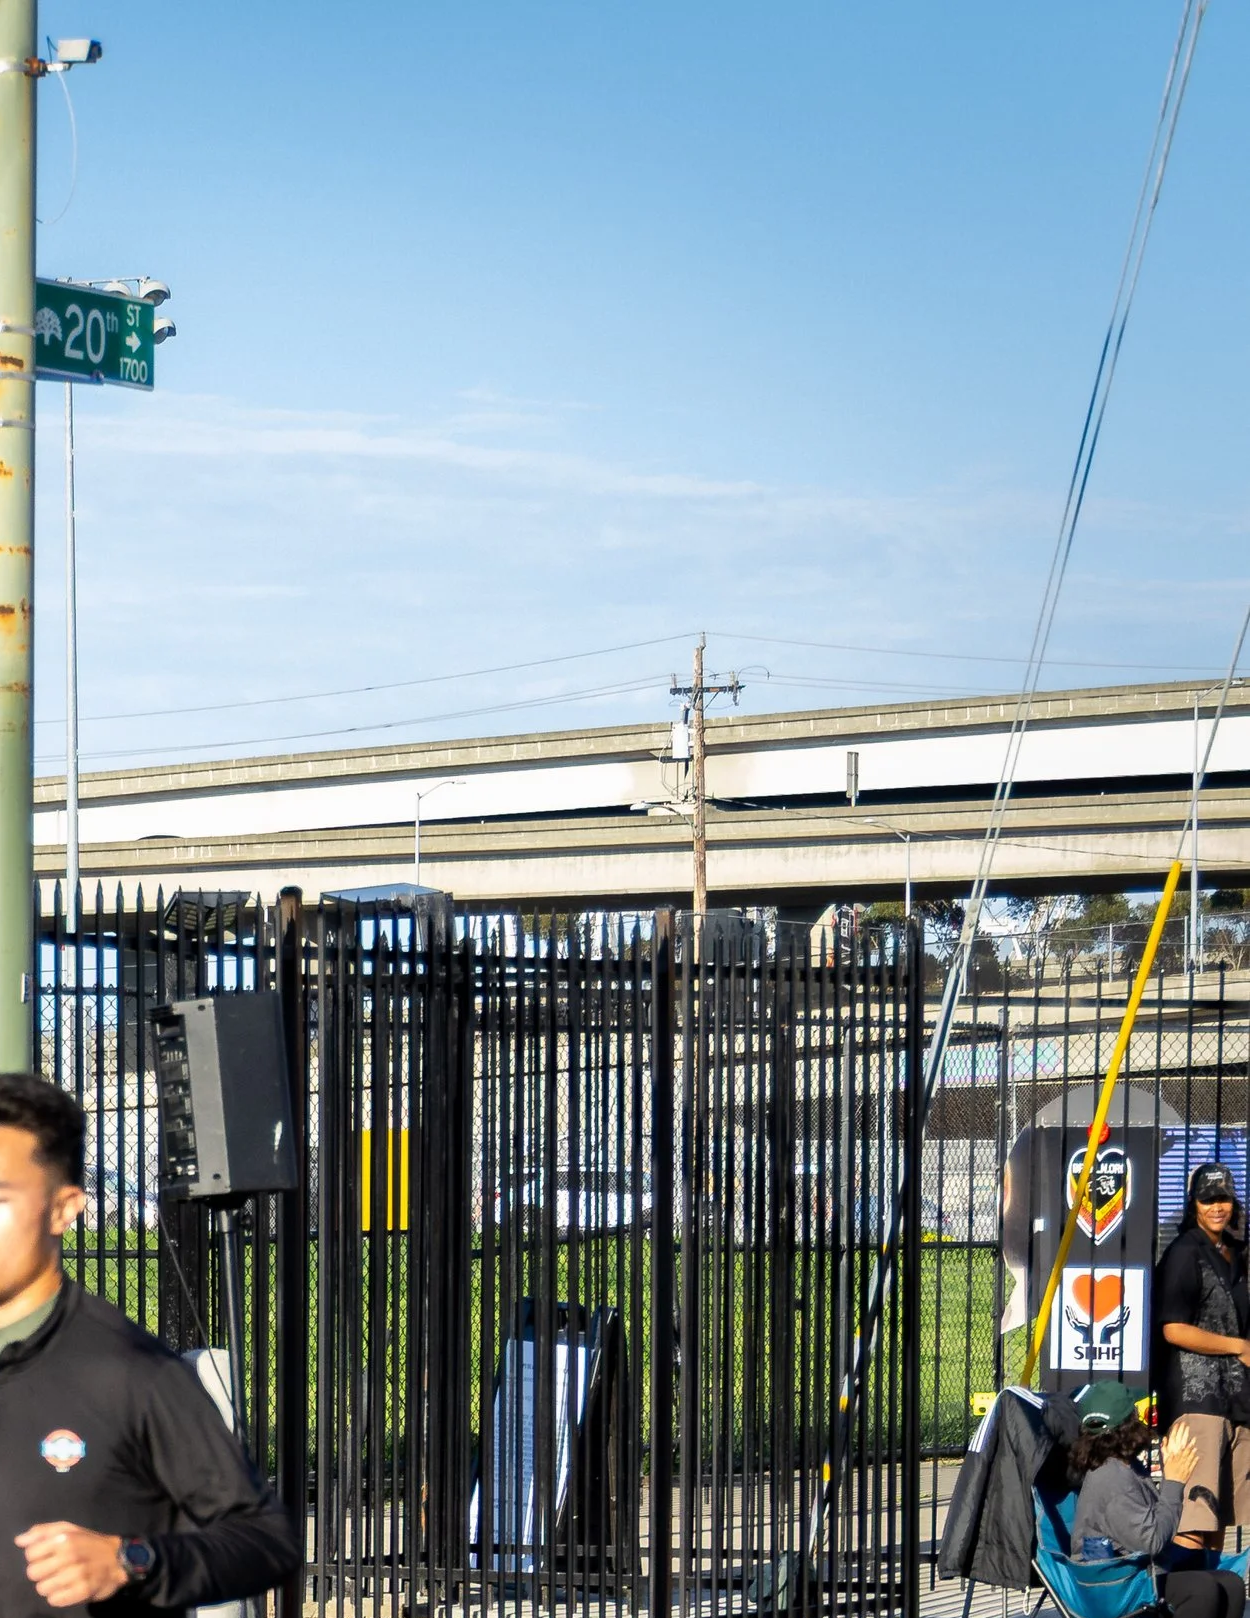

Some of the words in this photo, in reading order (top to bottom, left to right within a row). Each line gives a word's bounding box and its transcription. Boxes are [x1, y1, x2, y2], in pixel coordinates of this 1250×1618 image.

[126, 303, 142, 328] ST
[64, 303, 119, 364] 20th
[119, 356, 148, 384] 1700
